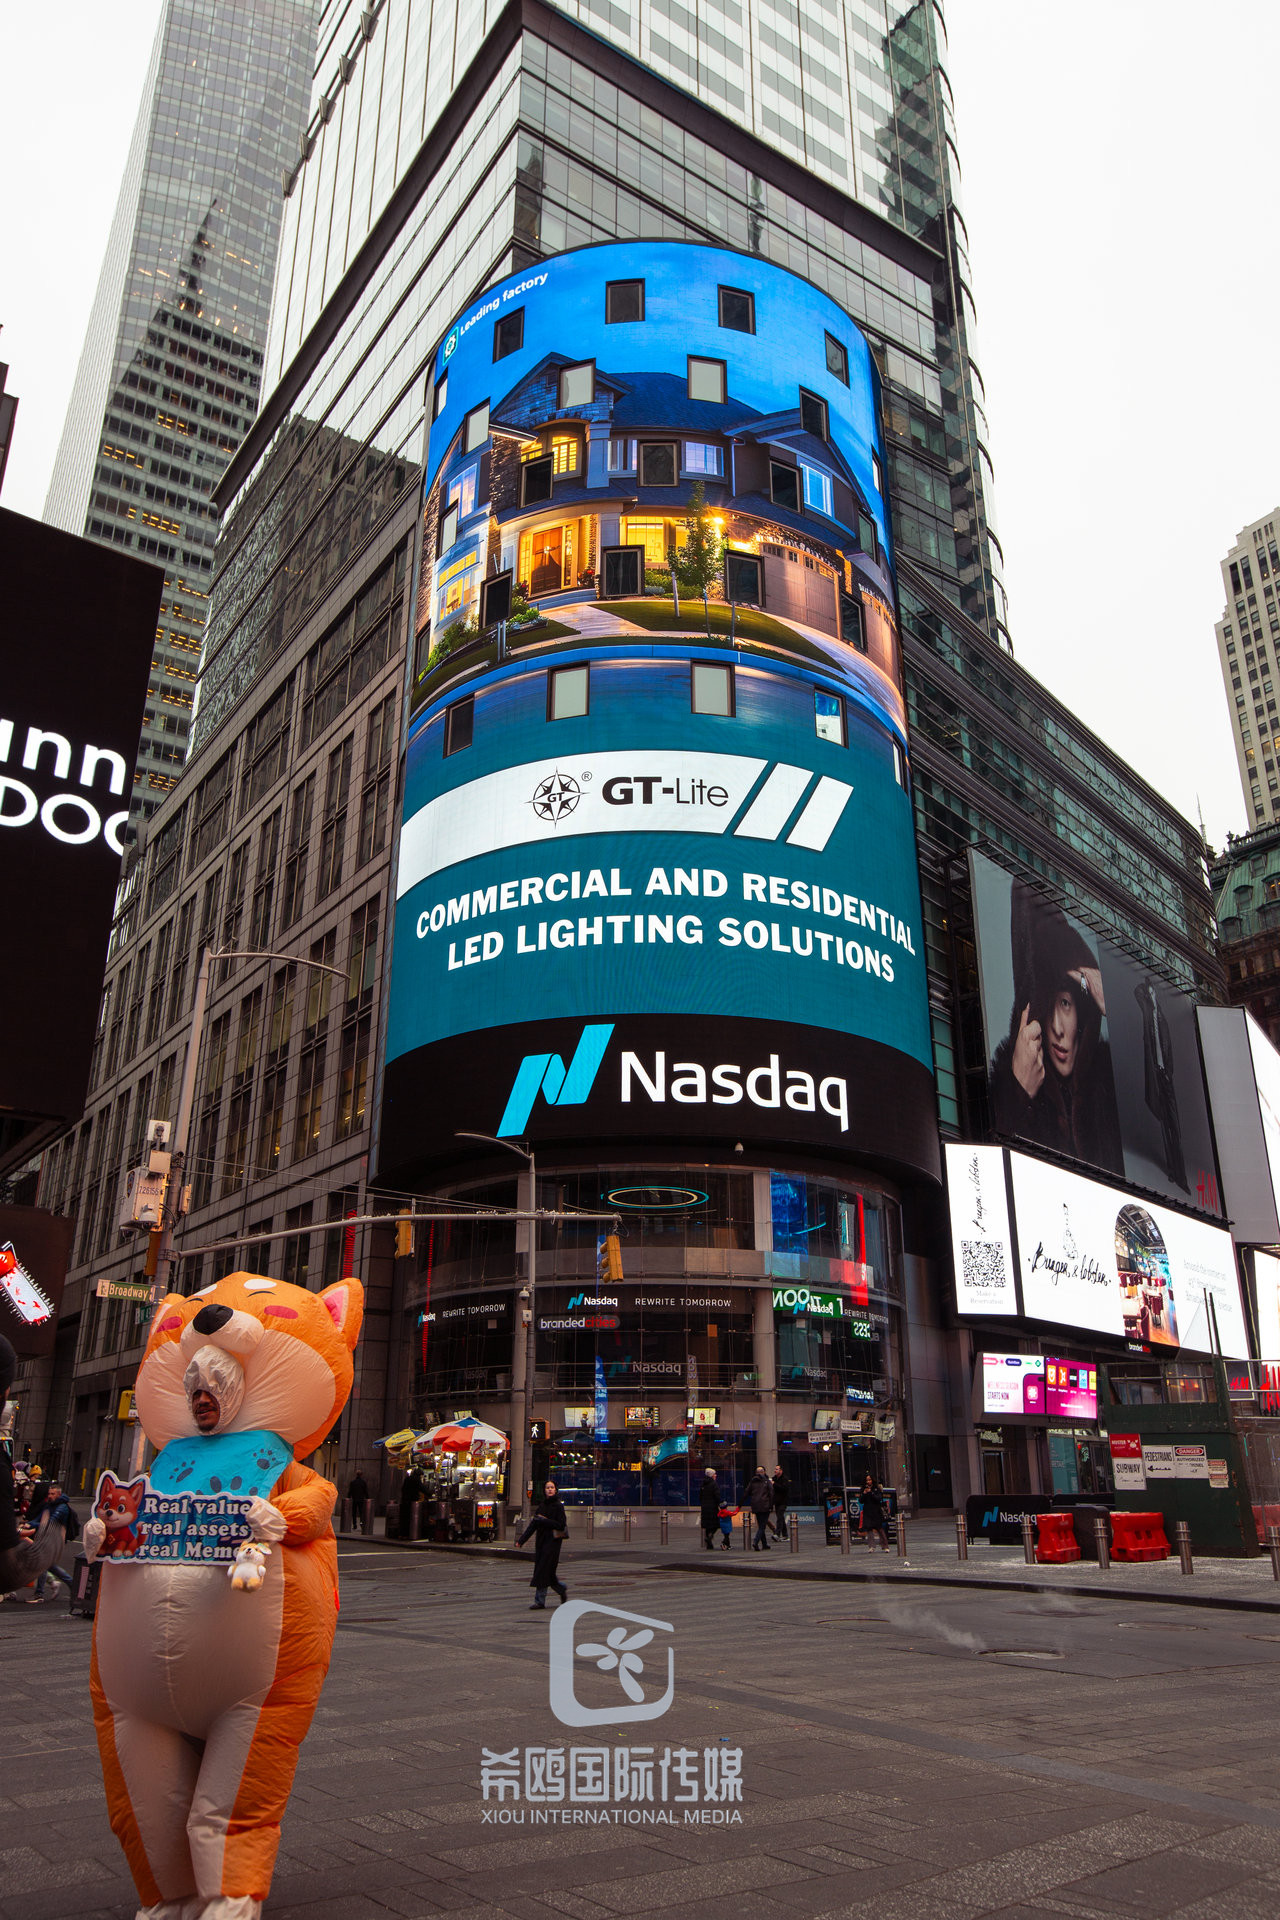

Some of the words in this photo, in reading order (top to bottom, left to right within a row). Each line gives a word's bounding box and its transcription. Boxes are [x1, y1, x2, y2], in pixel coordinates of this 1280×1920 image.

[460, 298, 500, 336] Leading
[503, 273, 548, 302] factory
[547, 792, 565, 802] GT
[602, 776, 729, 807] GT-Lite
[416, 868, 632, 939] COMMERCIAL
[645, 867, 728, 898] AND
[743, 872, 916, 956] RESIDENTIAL
[448, 931, 504, 971] LED
[517, 914, 703, 954] LIGHTING
[718, 917, 895, 983] SOLUTIONS
[621, 1051, 849, 1132] Nasdaq
[109, 1283, 149, 1302] Broadway
[584, 1296, 618, 1307] Nasdaq
[635, 1298, 676, 1306] REWRITE
[680, 1298, 732, 1307] TOMORROW
[443, 1308, 466, 1318] REWRITE
[632, 1361, 681, 1376] Nasdaq
[1144, 1452, 1173, 1462] PEDESTRIANS
[1116, 1463, 1141, 1474] SUBWAY
[144, 1498, 191, 1515] Real
[194, 1499, 250, 1516] value
[141, 1520, 181, 1537] real
[187, 1521, 249, 1537] assets
[138, 1541, 179, 1558] real
